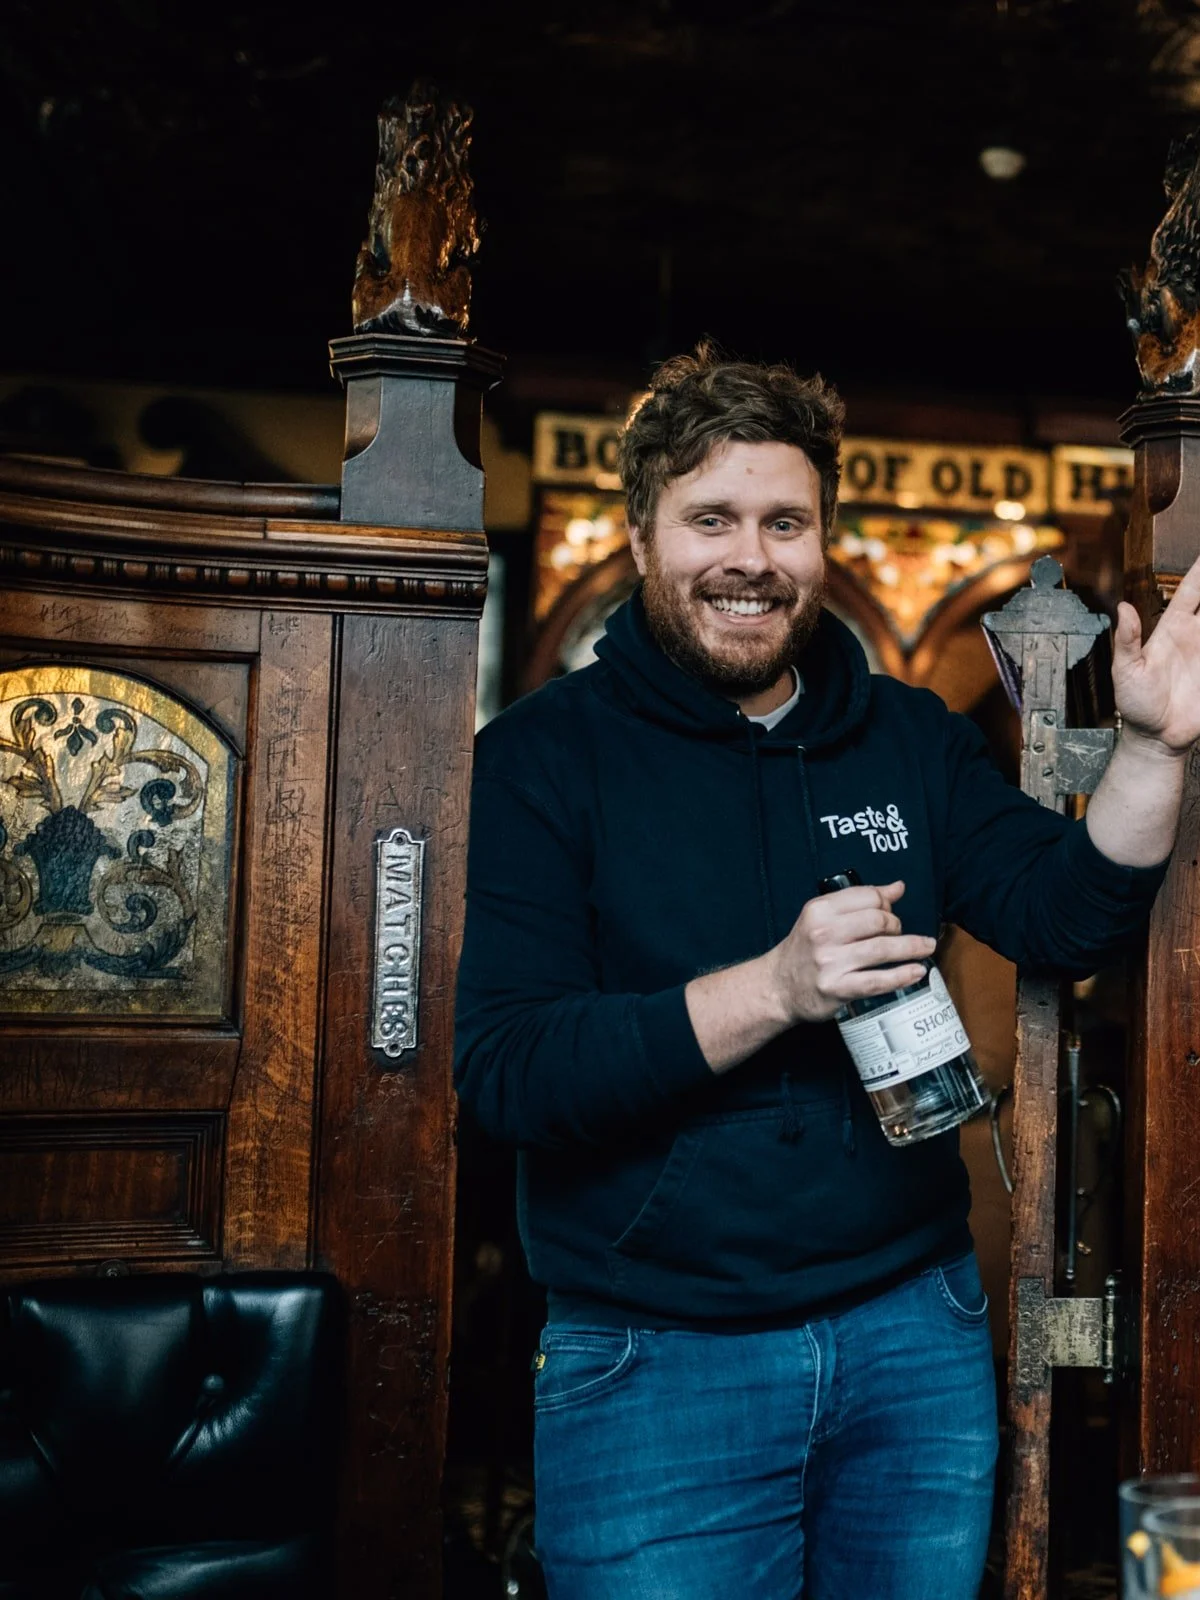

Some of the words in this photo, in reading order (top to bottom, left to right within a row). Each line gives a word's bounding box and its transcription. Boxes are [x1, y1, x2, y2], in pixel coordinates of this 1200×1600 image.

[847, 453, 909, 492] OF
[931, 458, 1032, 500] OLD
[861, 829, 908, 852] Tour
[380, 855, 412, 1039] MATCHES
